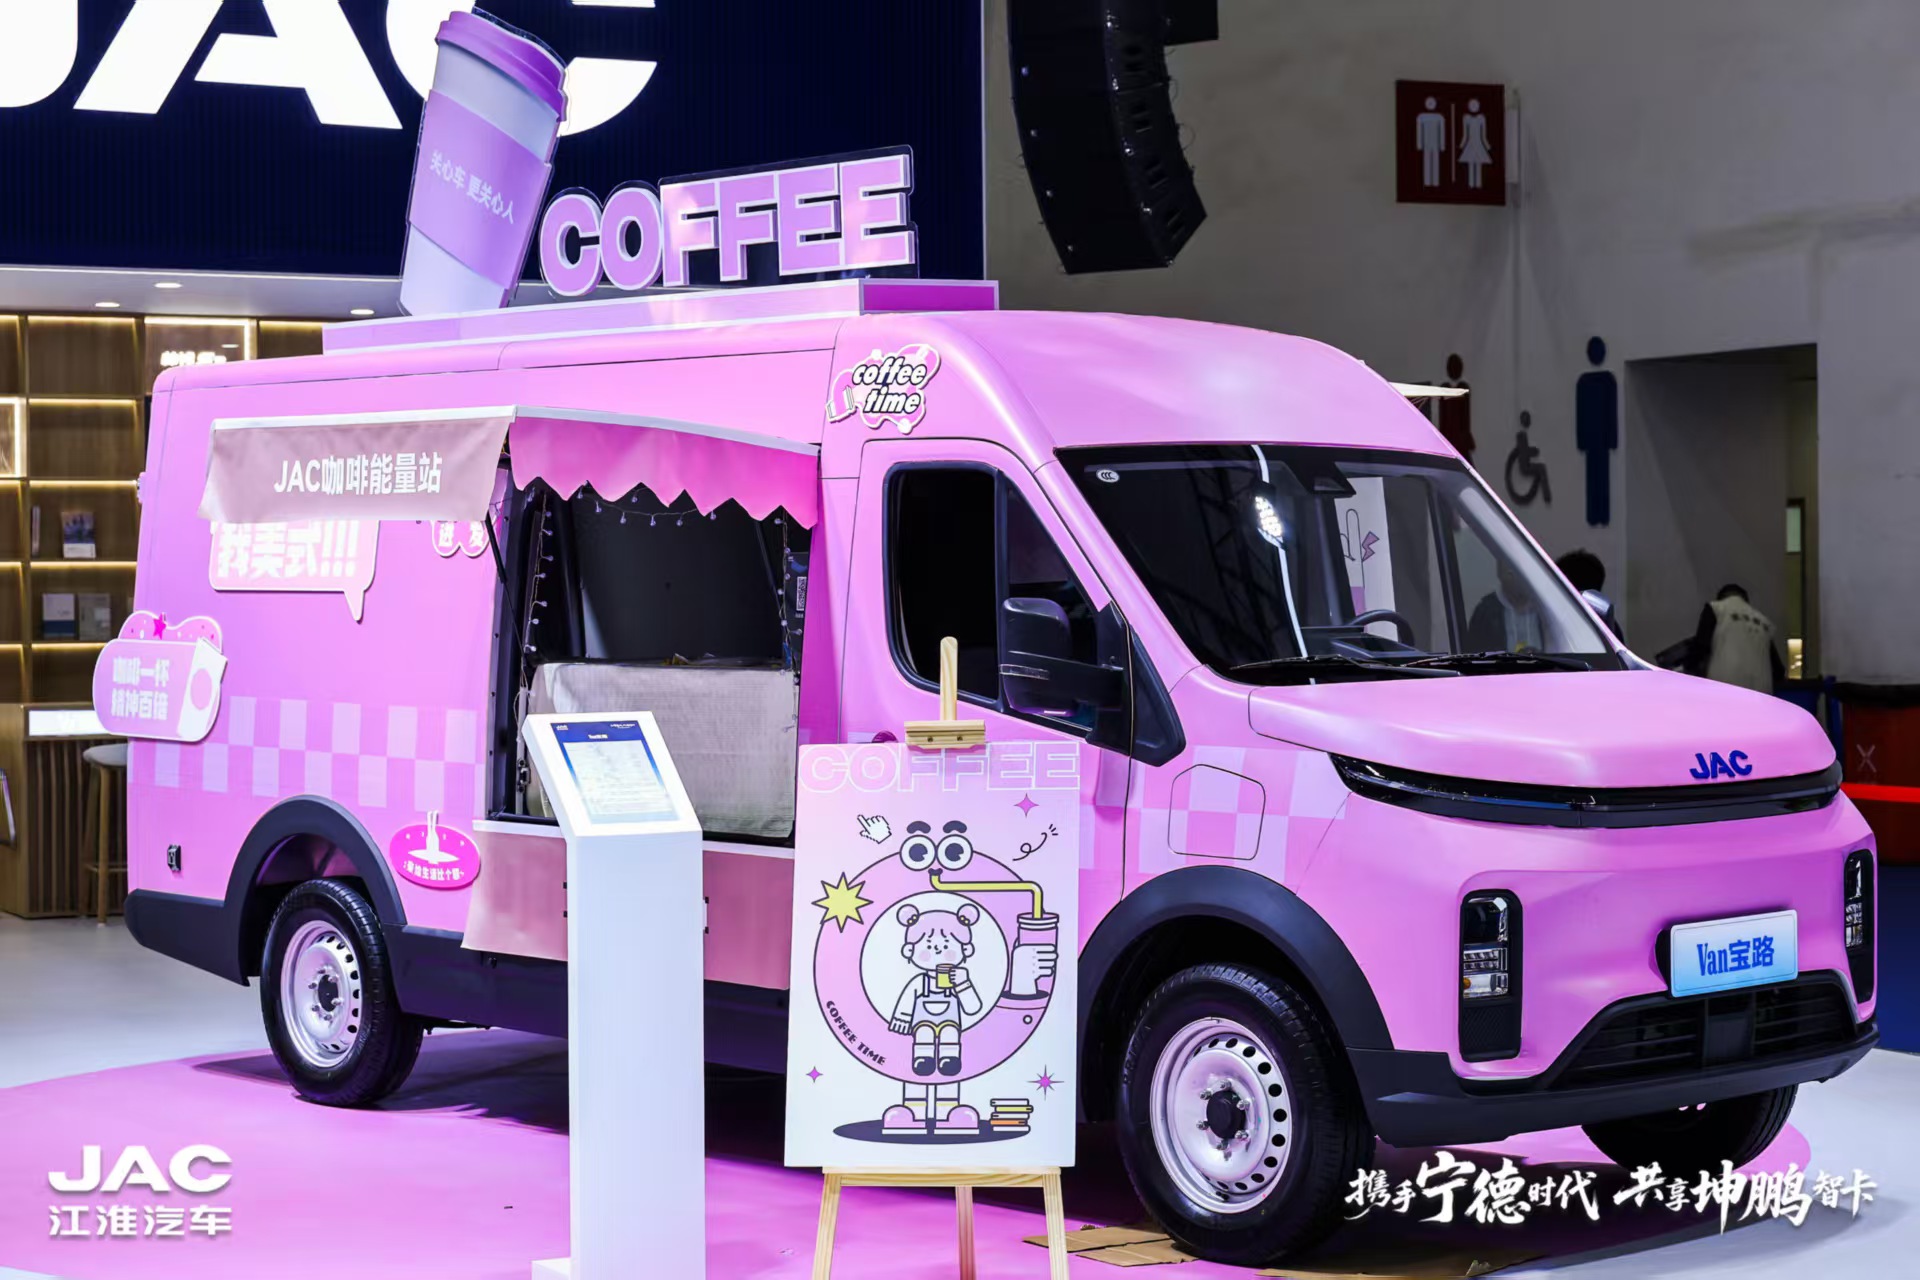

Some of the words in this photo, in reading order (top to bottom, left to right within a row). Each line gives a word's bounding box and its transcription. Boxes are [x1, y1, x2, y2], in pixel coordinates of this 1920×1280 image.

[0, 0, 657, 137] AC
[430, 150, 466, 189] 关心车
[467, 174, 514, 225] 更关心人
[539, 154, 915, 297] COFFEE
[852, 356, 928, 386] coffee
[863, 385, 921, 414] time
[274, 452, 442, 495] JAC咖啡能量站
[799, 741, 1080, 793] COFFEE
[1689, 750, 1753, 780] JAC
[1697, 935, 1775, 976] Van宝路
[826, 1000, 858, 1044] COFFEE
[857, 1041, 887, 1066] TIME
